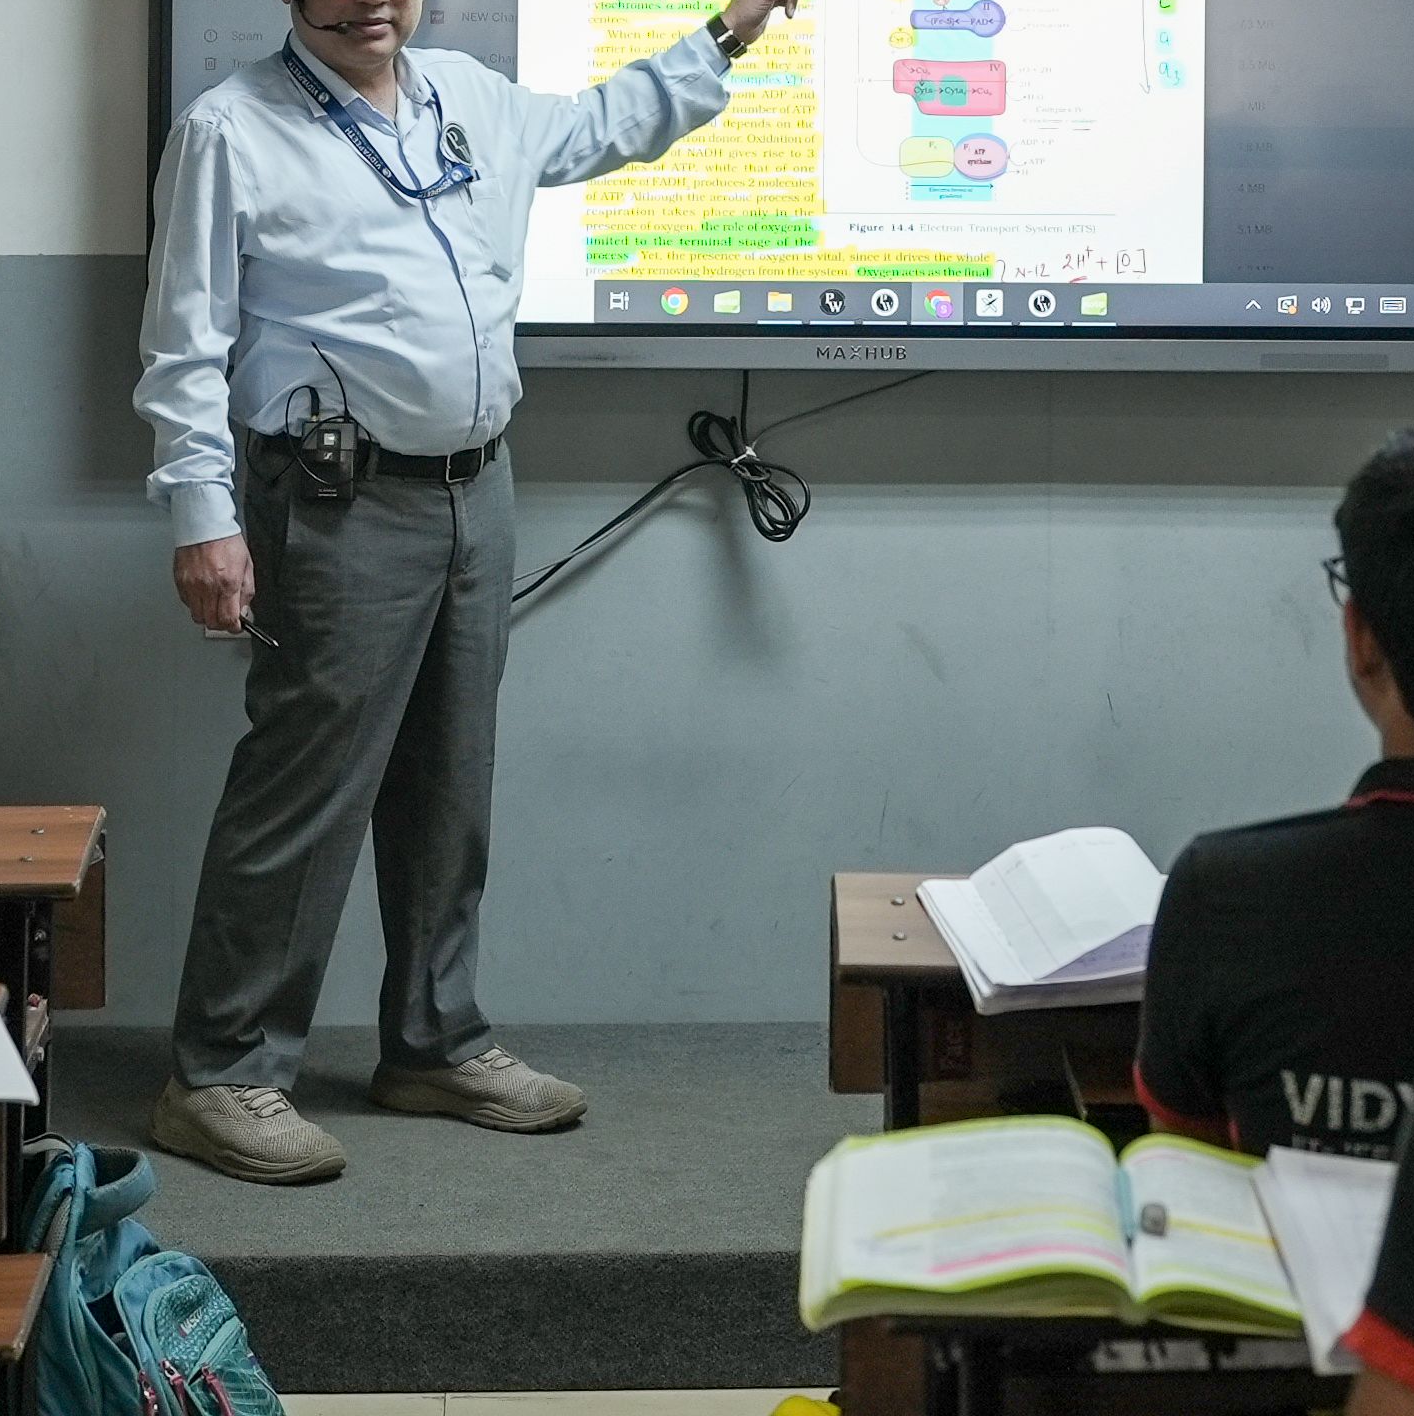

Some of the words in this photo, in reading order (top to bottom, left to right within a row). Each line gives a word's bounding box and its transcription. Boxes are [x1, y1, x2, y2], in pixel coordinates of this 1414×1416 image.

[585, 223, 637, 233] presence
[701, 221, 719, 231] the
[723, 221, 744, 232] role
[747, 222, 759, 231] of
[761, 224, 801, 233] oxygen
[804, 223, 814, 232] is
[849, 223, 884, 234] Figure
[891, 223, 914, 232] 14.4
[919, 223, 963, 232] Electron
[970, 223, 1019, 234] Transport
[1025, 224, 1063, 233] System
[586, 236, 628, 245] limited
[635, 237, 647, 245] to
[653, 236, 673, 246] the
[679, 236, 731, 246] terminal
[738, 239, 771, 247] stage
[776, 238, 787, 246] of
[795, 237, 813, 246] the
[667, 251, 685, 260] the
[689, 253, 741, 262] presence
[744, 252, 755, 261] of
[759, 253, 799, 262] oxygen
[803, 253, 813, 261] is
[849, 252, 880, 262] since
[883, 252, 891, 261] it
[895, 252, 930, 262] drives
[934, 252, 952, 262] the
[955, 252, 990, 262] whole
[856, 267, 899, 279] Oxygen
[943, 267, 961, 276] the
[964, 267, 989, 277] final
[816, 345, 907, 360] MAXHUB
